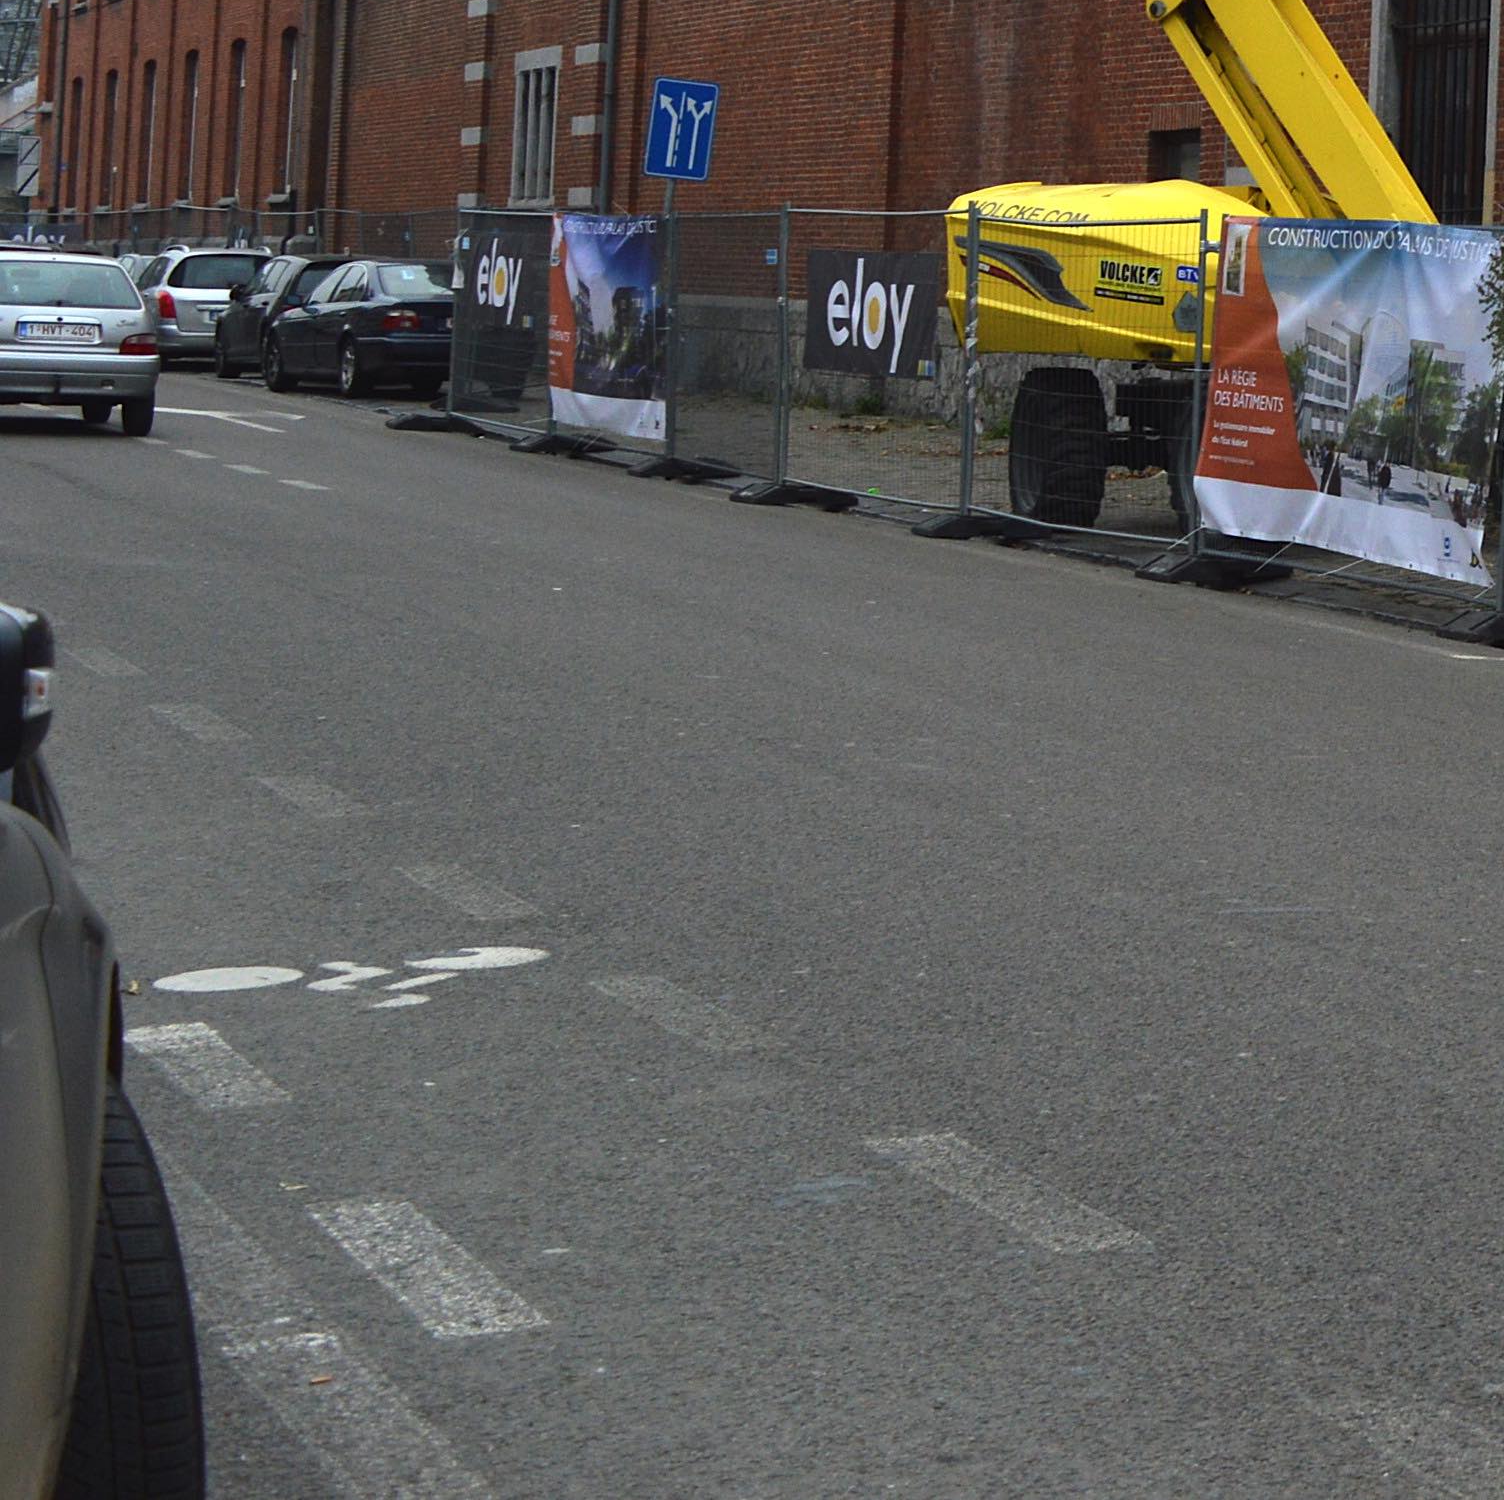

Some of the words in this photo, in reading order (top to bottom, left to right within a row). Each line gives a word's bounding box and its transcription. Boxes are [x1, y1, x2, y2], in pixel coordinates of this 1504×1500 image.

[1268, 227, 1370, 249] CONSTRUCTION
[477, 238, 522, 325] eloy
[1100, 260, 1145, 284] VOLCKE
[827, 258, 915, 373] eloy
[1218, 368, 1229, 383] LA
[1214, 390, 1231, 406] DES
